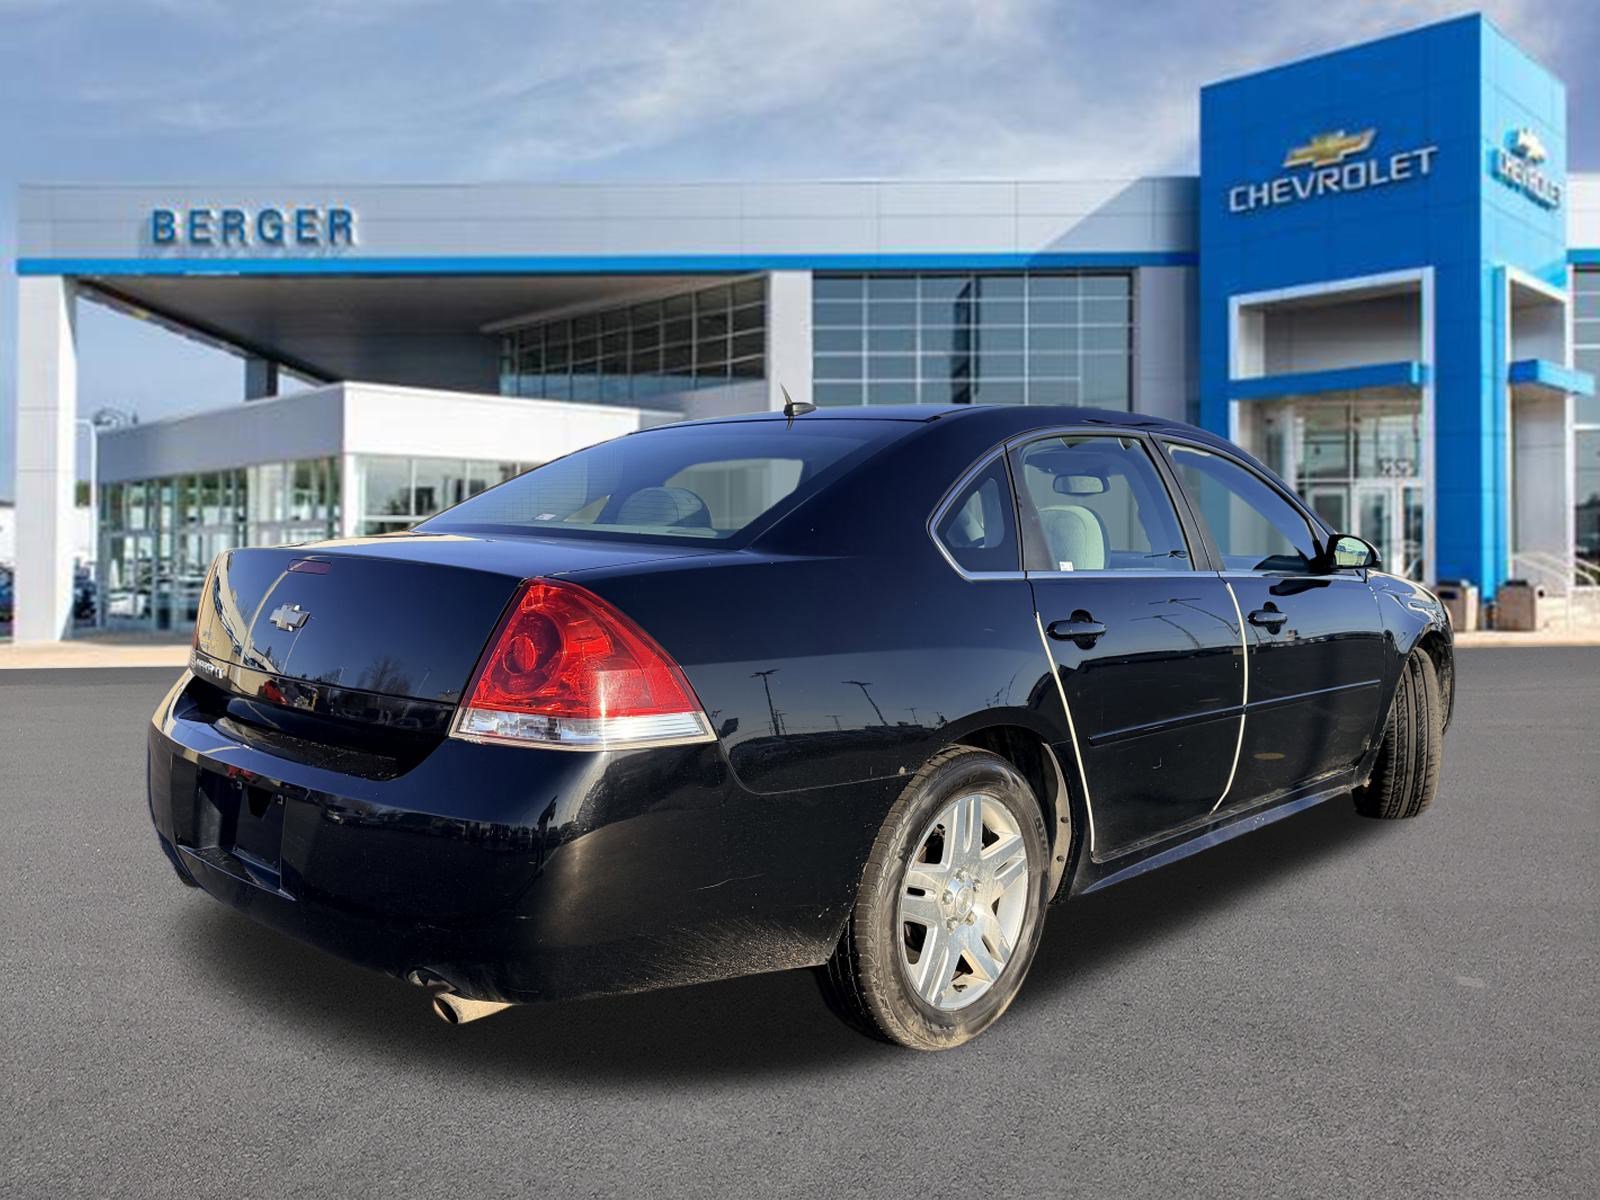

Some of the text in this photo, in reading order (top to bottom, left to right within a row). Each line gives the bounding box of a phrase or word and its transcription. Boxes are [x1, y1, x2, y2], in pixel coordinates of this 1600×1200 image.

[1229, 146, 1438, 213] CHEVROLET
[1494, 148, 1563, 210] CHEVROLE
[151, 205, 355, 247] BERGER
